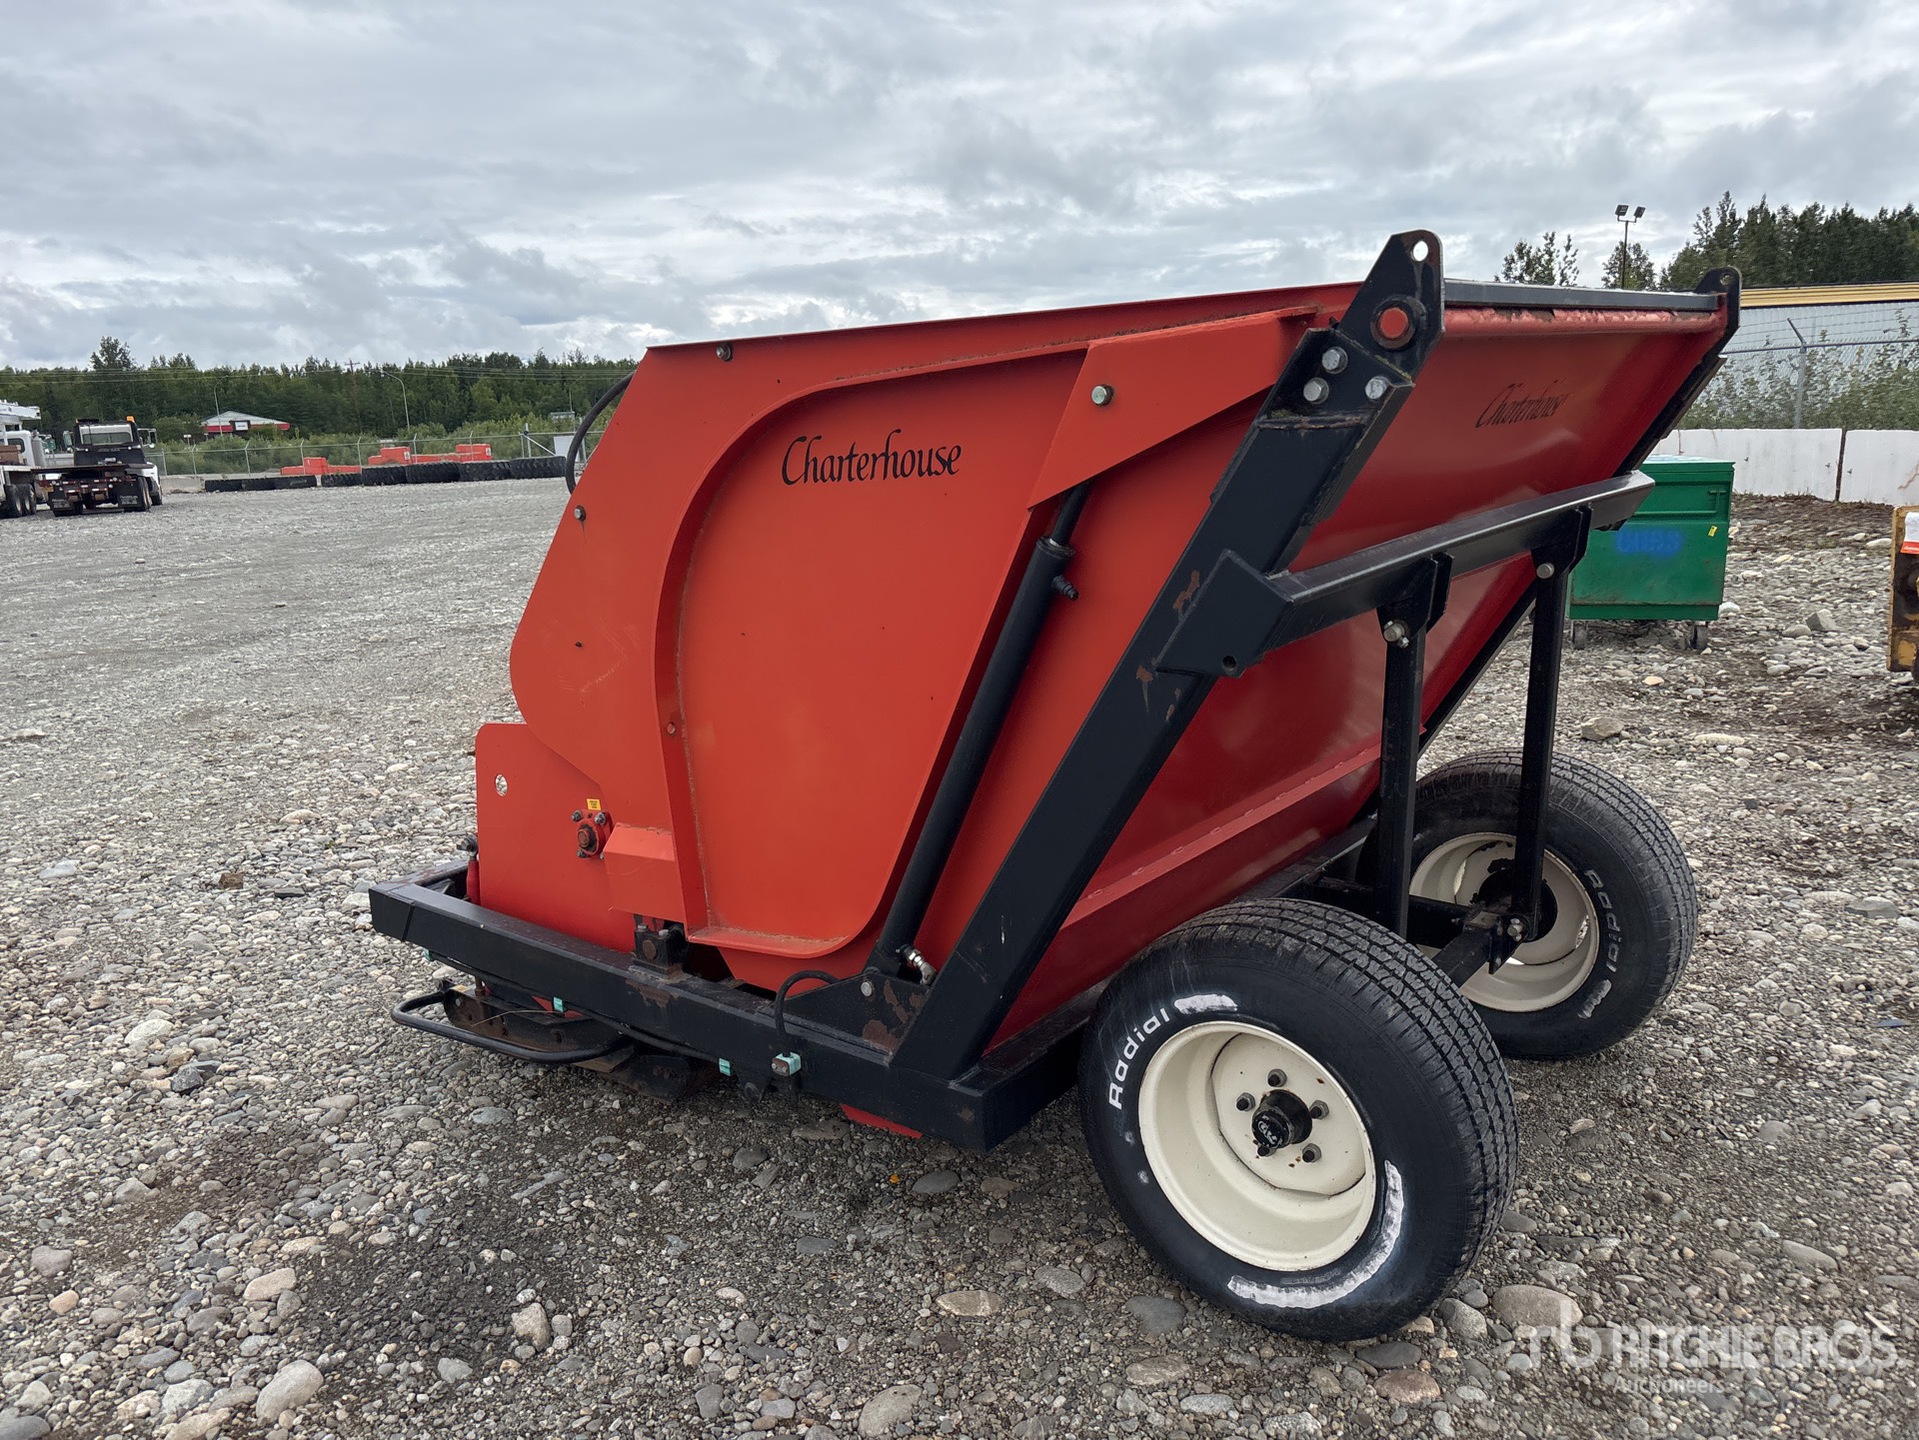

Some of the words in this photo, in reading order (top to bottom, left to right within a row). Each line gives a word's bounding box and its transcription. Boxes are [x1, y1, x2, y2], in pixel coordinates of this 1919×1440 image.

[781, 429, 962, 486] Charterhouse
[1583, 869, 1621, 973] Radial
[1108, 1008, 1170, 1110] Radial
